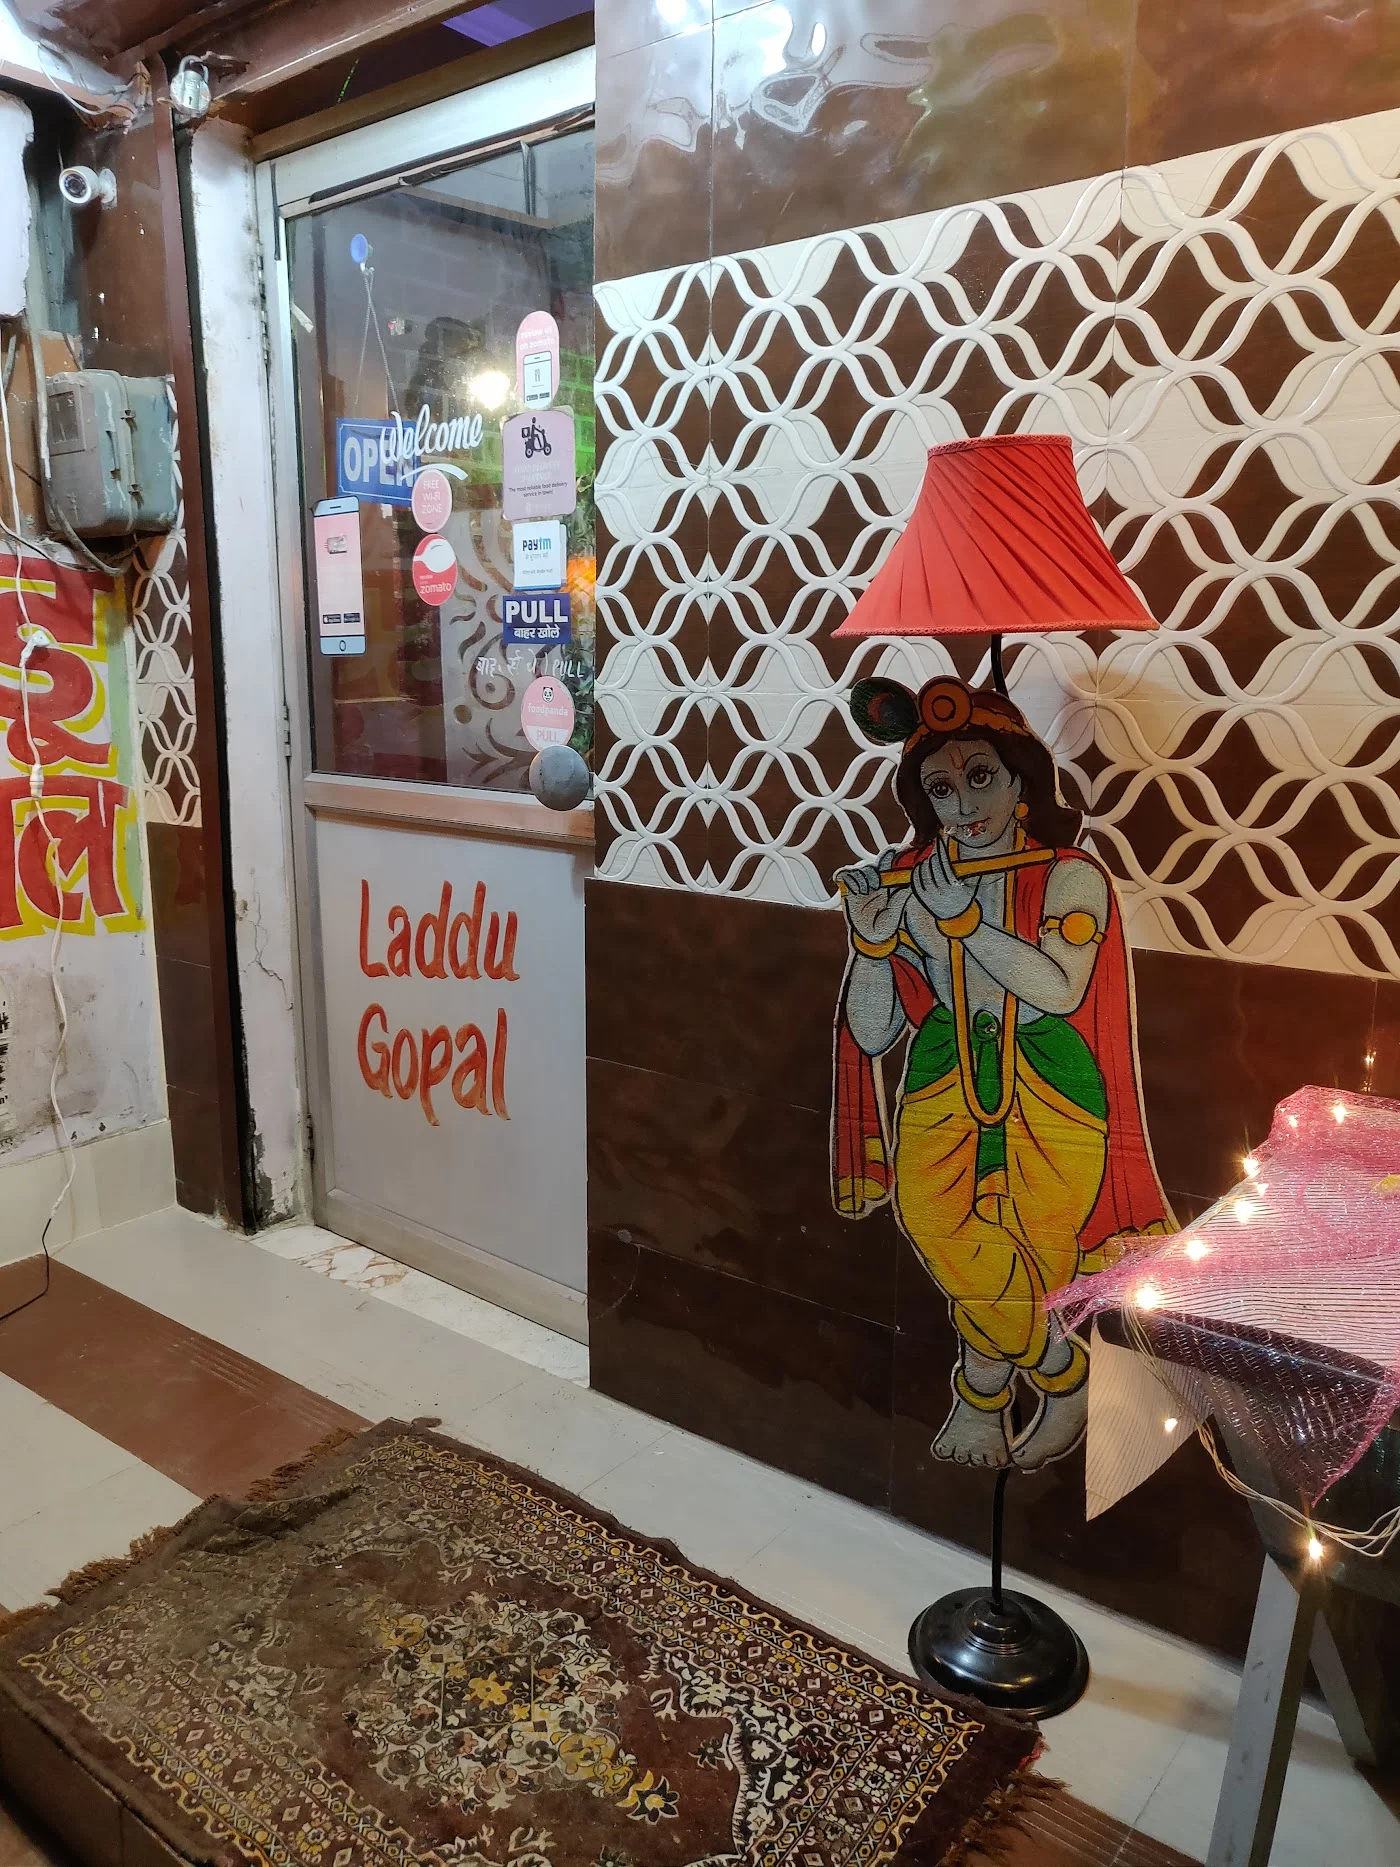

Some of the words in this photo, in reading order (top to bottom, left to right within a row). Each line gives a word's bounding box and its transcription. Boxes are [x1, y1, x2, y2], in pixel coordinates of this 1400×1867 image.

[380, 403, 483, 465] Welcome
[423, 479, 440, 490] FREE
[421, 503, 442, 514] ZONE
[419, 582, 452, 595] zomato
[505, 599, 569, 624] PULL
[513, 627, 537, 640] बाहर
[552, 658, 584, 678] PULL
[527, 702, 569, 717] foodpanda
[536, 729, 560, 743] PULL
[359, 878, 521, 981] Laddu
[357, 1002, 512, 1127] Gopal
